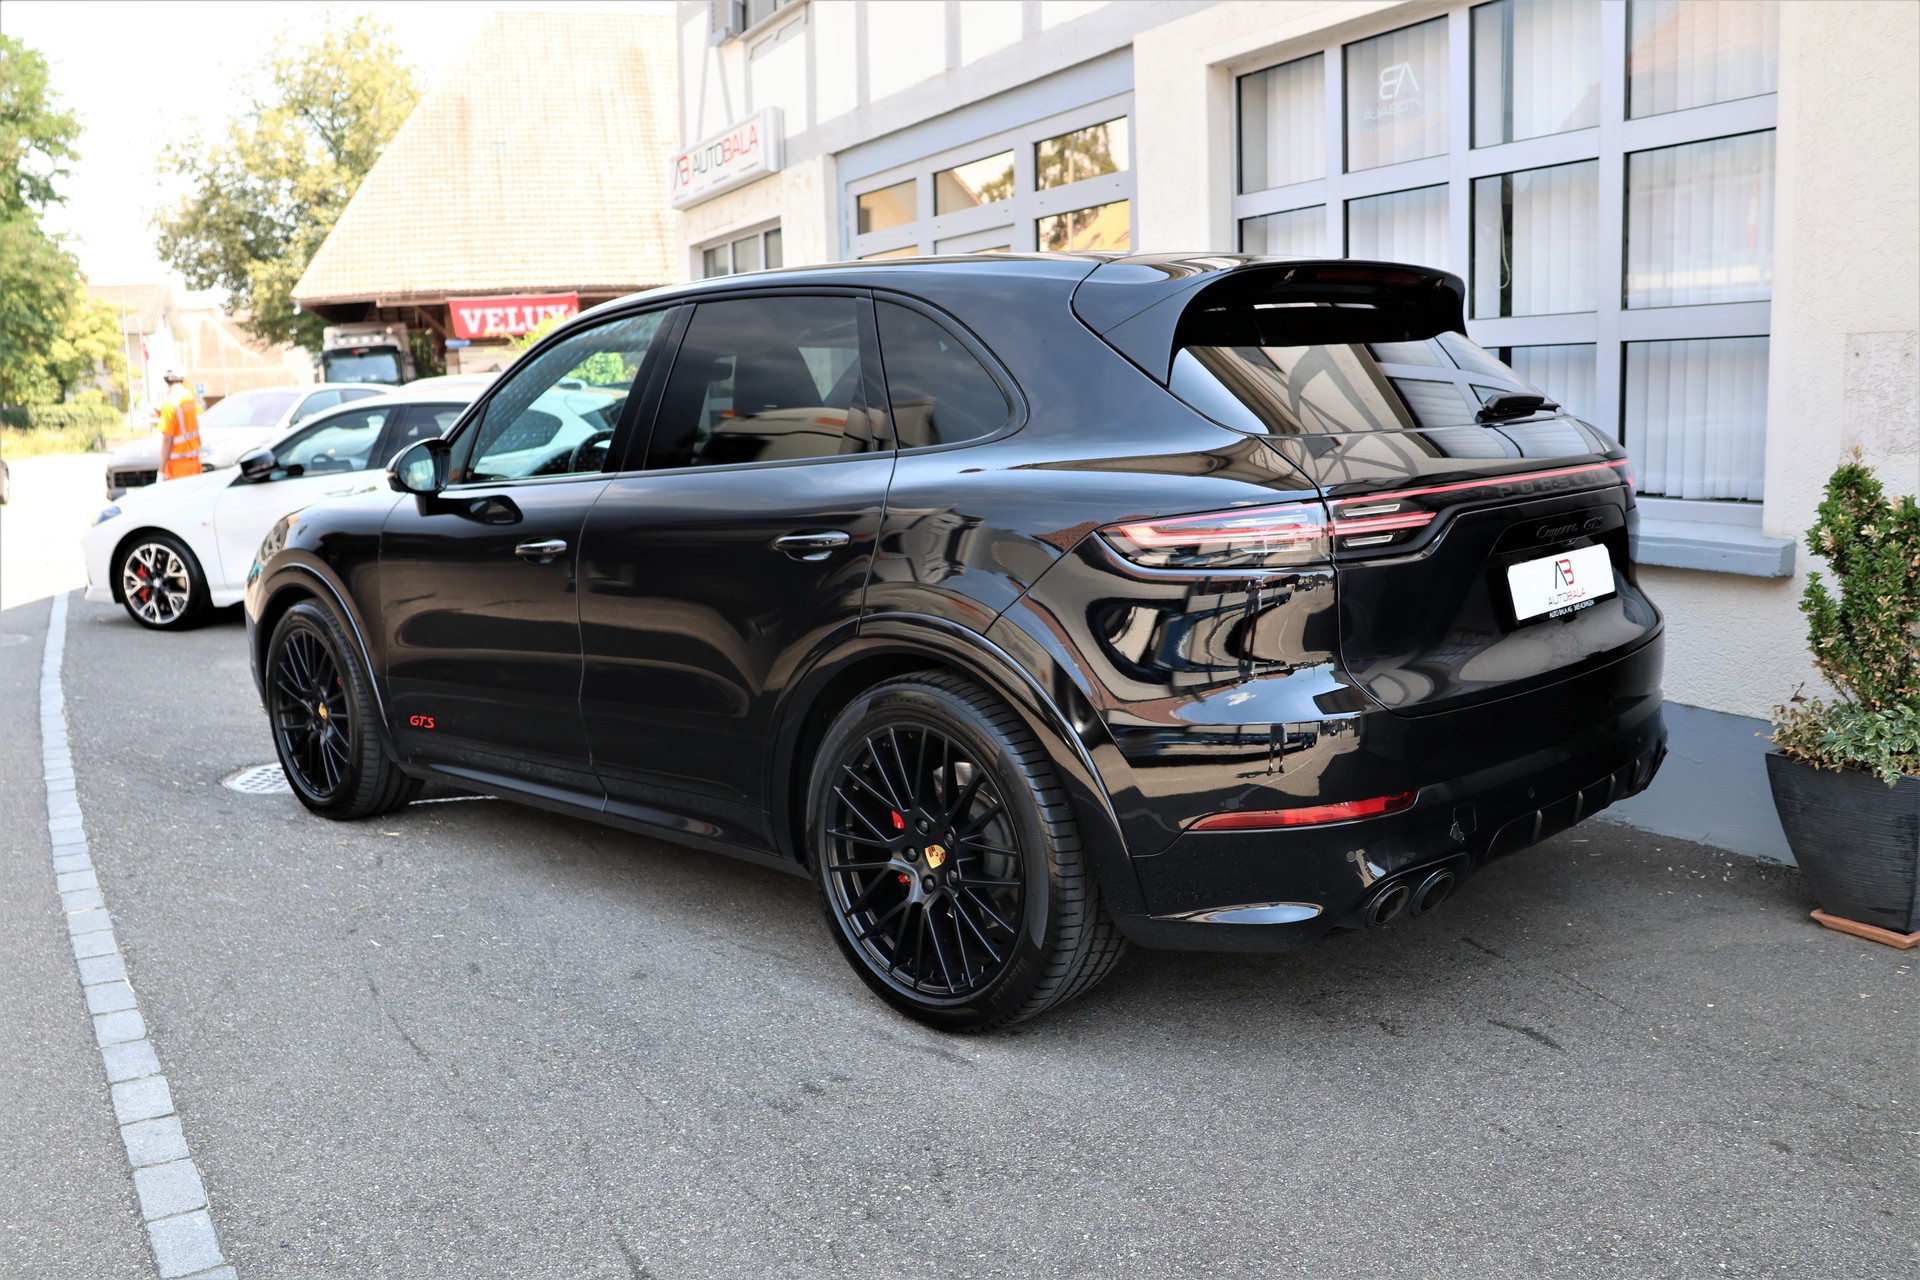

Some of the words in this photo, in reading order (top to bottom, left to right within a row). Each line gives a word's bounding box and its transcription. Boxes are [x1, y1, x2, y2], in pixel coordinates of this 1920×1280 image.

[692, 125, 759, 176] AUTOBALA
[1536, 524, 1578, 542] Cayenne
[1583, 516, 1604, 531] GTS
[1548, 587, 1586, 606] AUTOBALA
[410, 715, 435, 728] GTS
